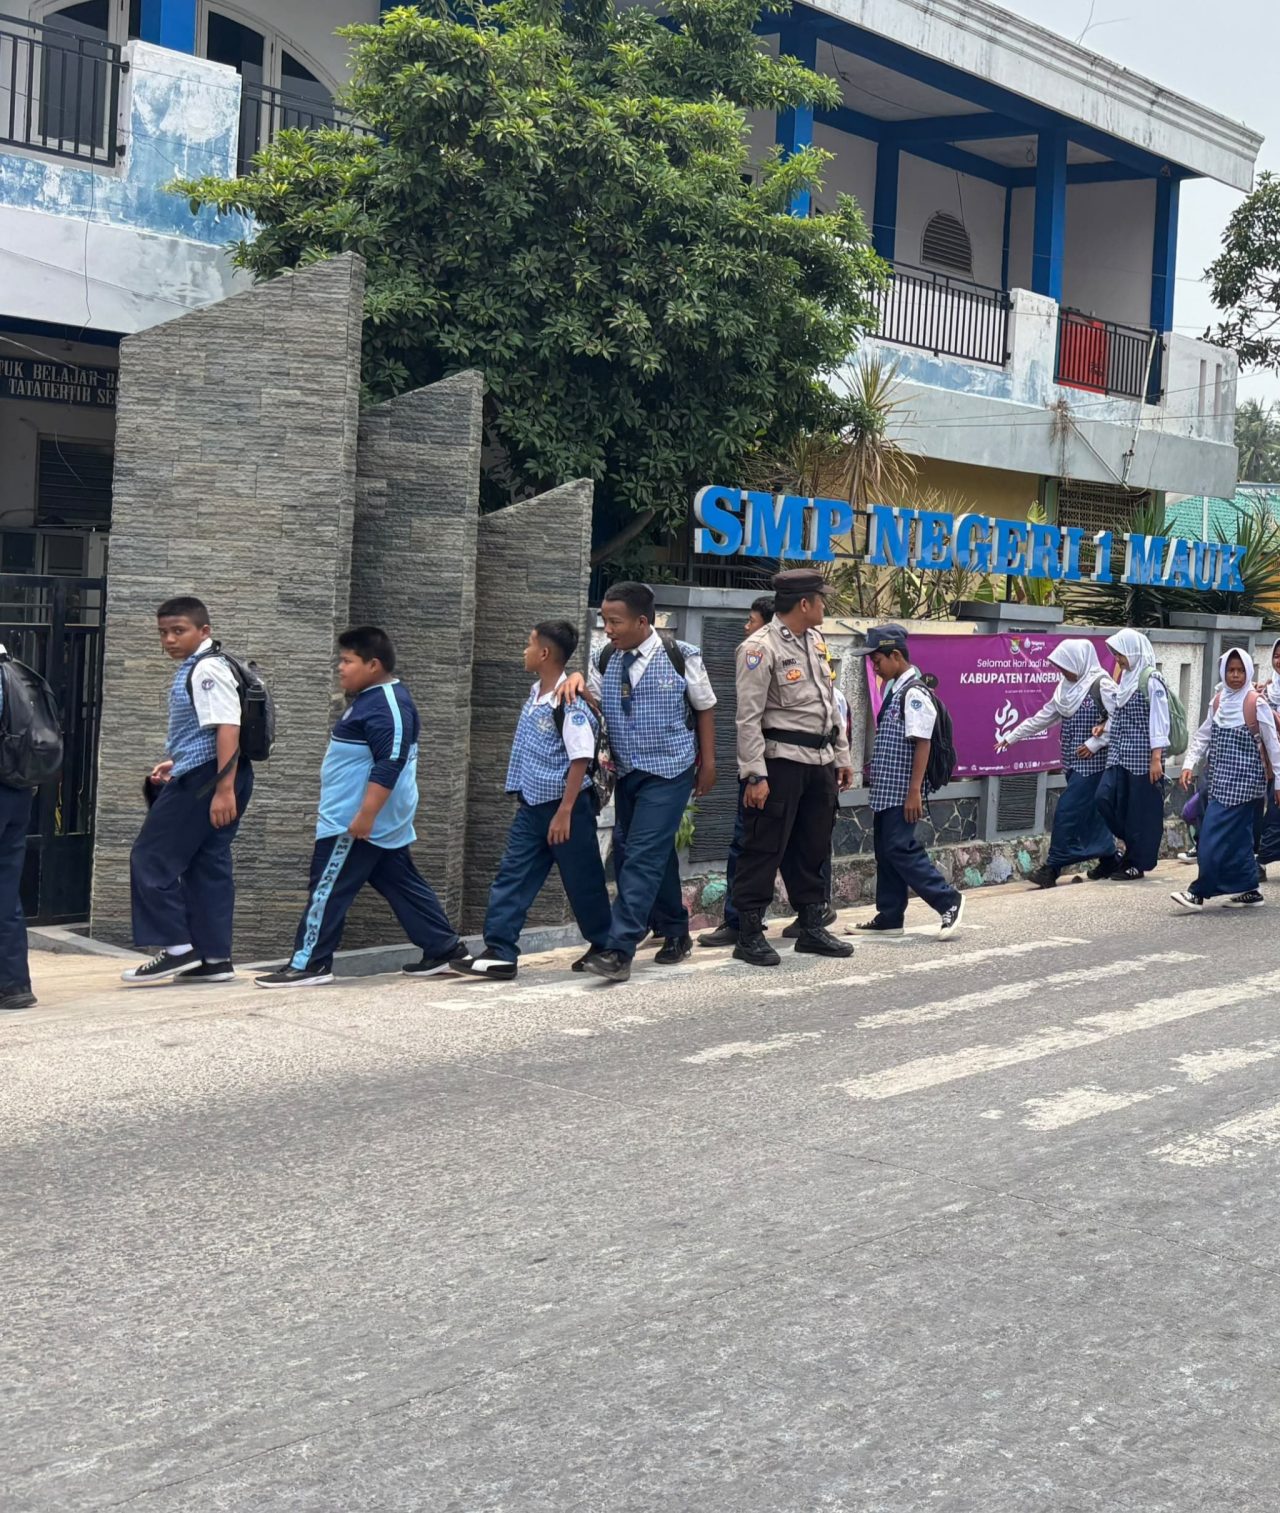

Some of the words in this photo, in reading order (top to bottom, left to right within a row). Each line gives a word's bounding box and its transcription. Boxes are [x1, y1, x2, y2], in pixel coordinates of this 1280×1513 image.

[33, 364, 97, 386] BELAJAR
[8, 378, 91, 402] TATATERTIB
[694, 485, 853, 561] SMP
[864, 504, 1084, 581] NEGERI
[1090, 530, 1113, 582] 1
[1121, 533, 1247, 592] MAUK
[977, 658, 1011, 668] Selamat
[960, 672, 1023, 684] KABUPATEN
